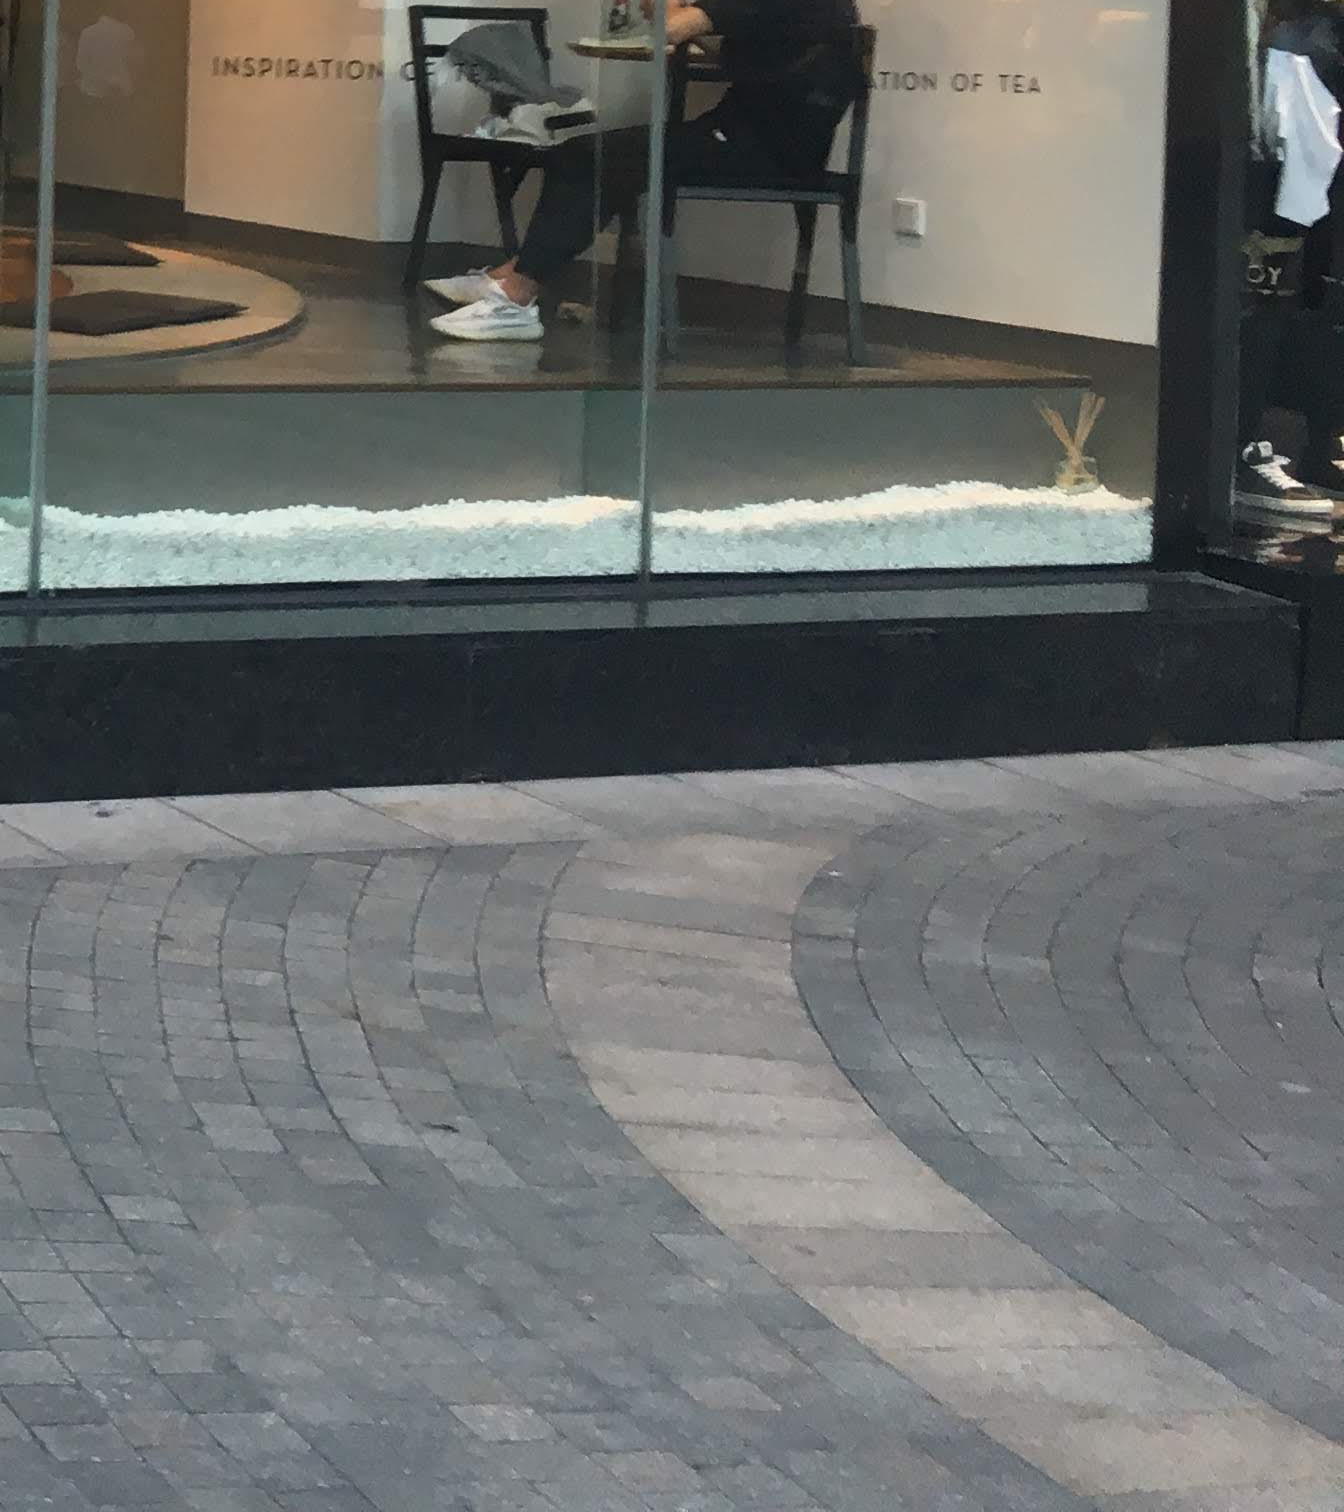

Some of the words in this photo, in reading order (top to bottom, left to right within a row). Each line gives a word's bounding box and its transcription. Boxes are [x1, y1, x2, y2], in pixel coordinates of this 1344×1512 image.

[213, 57, 385, 81] INSPIRATION
[951, 73, 983, 92] OF
[998, 74, 1041, 94] TEA
